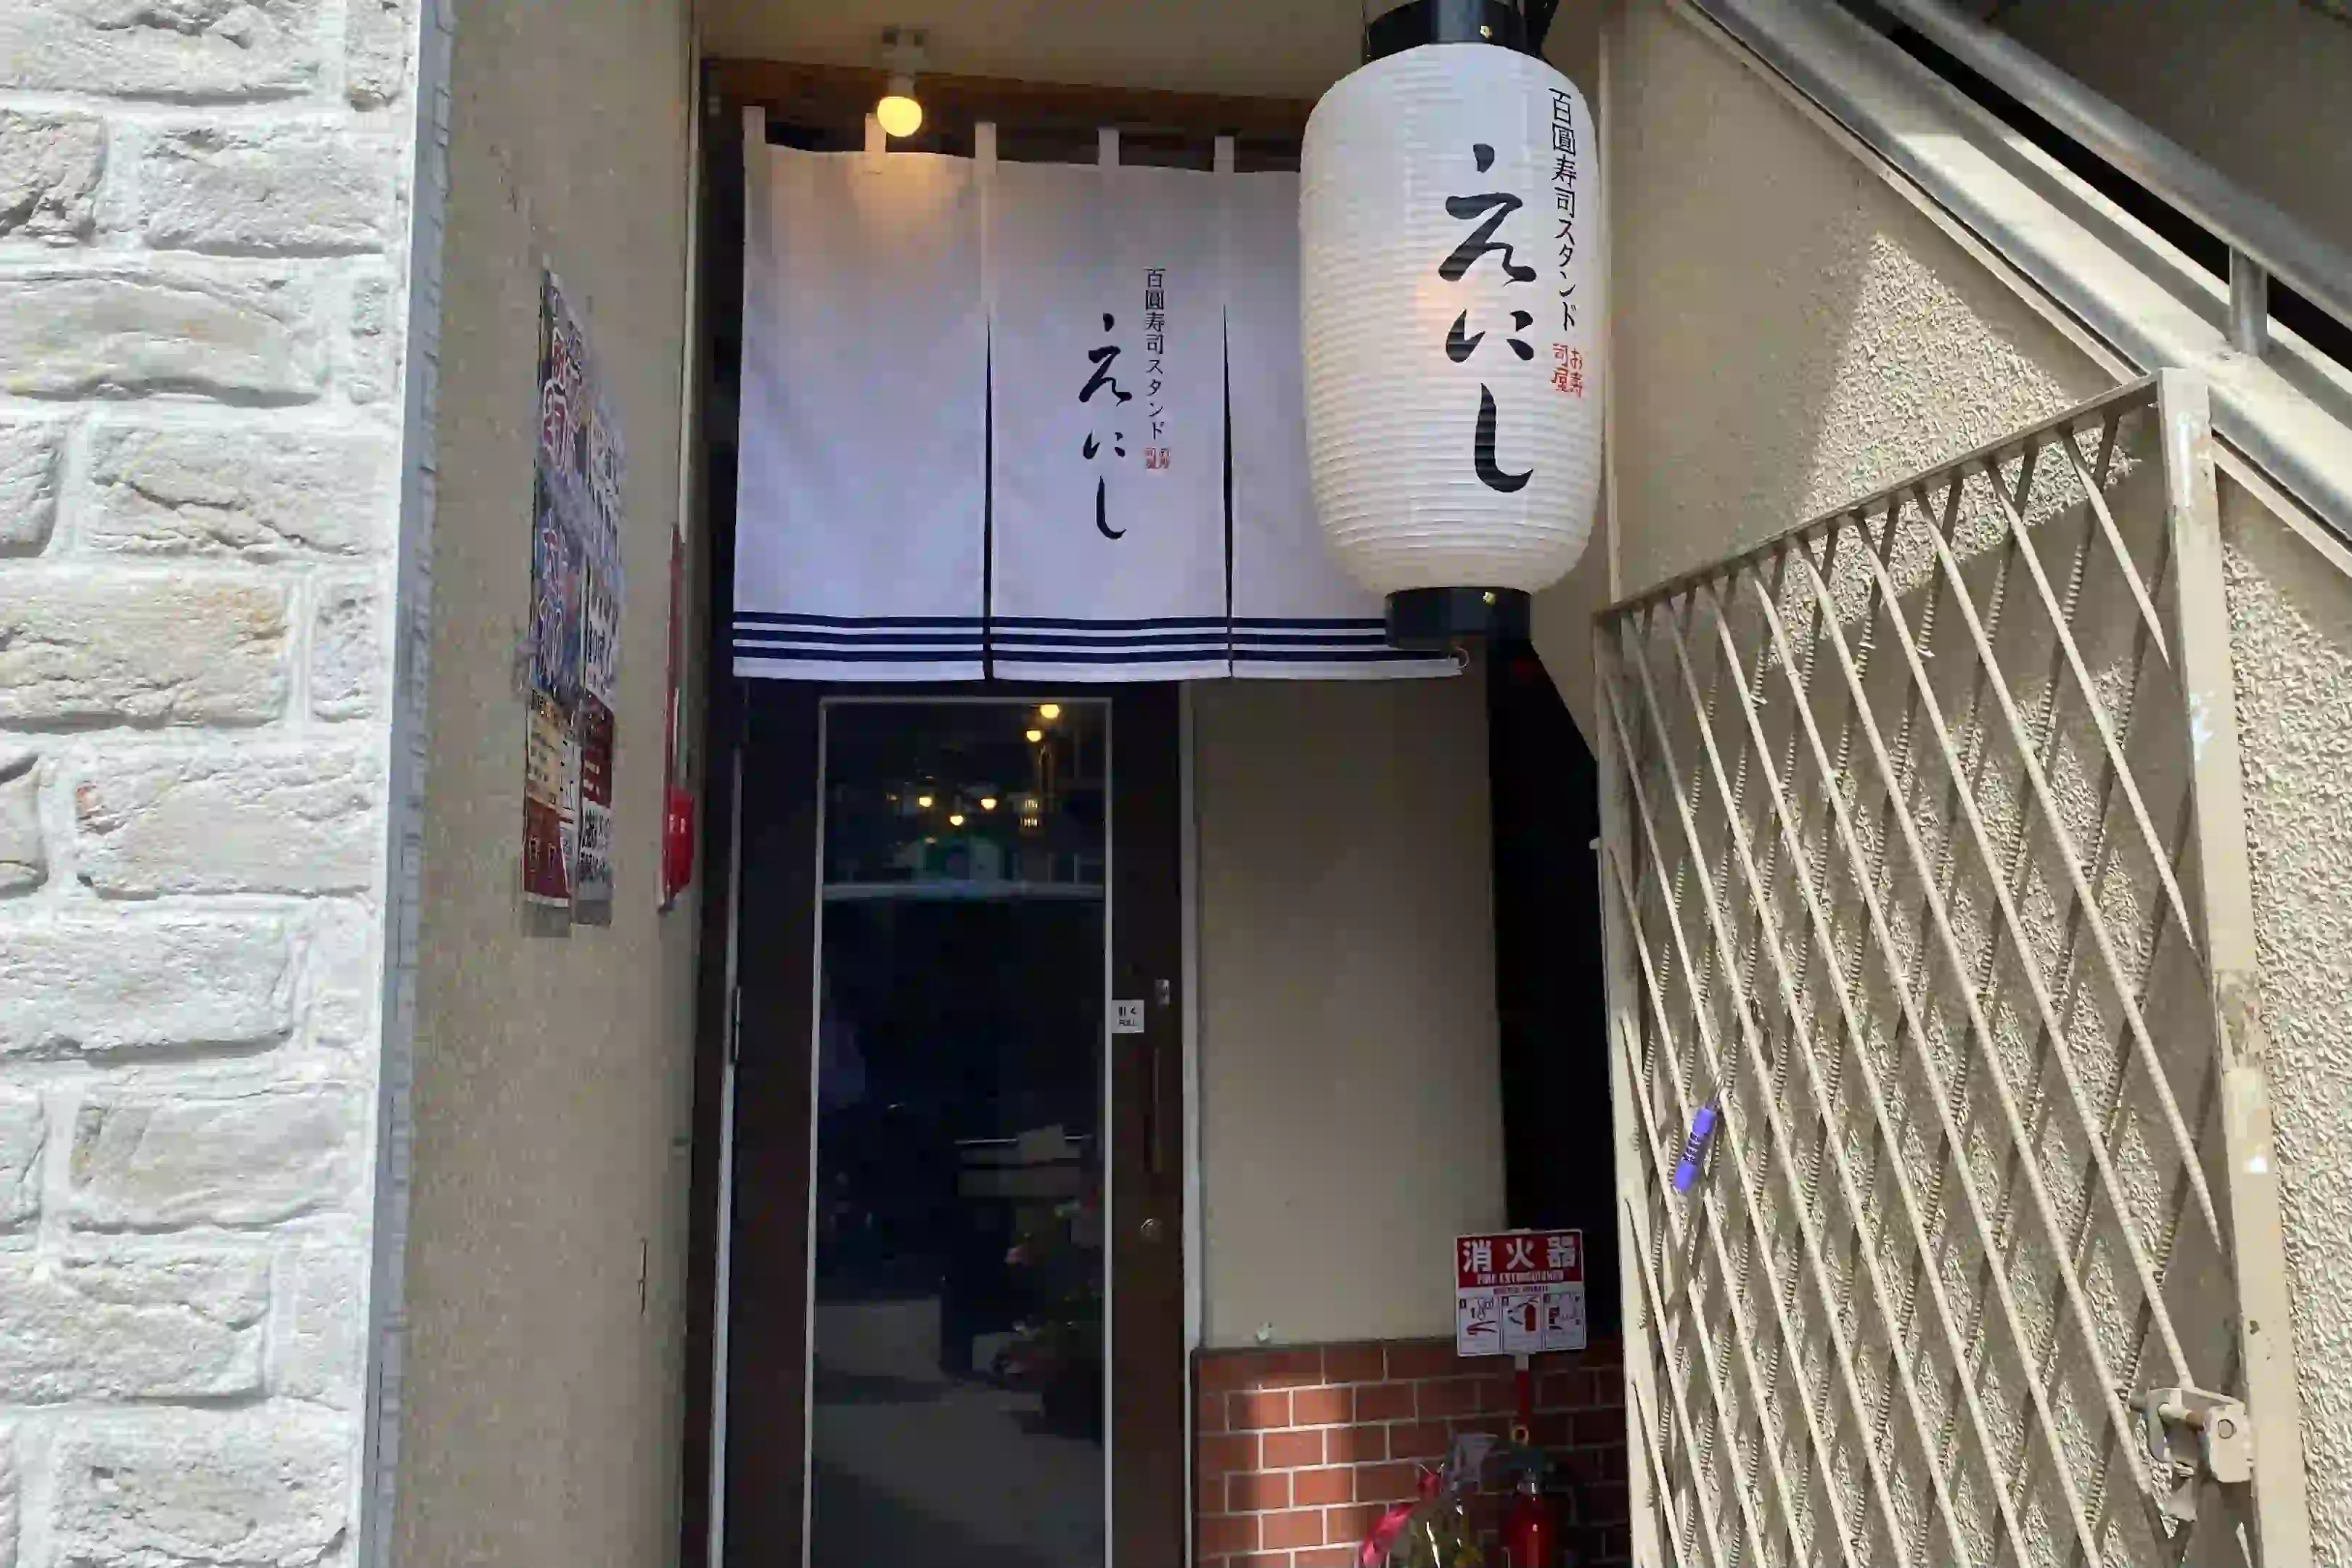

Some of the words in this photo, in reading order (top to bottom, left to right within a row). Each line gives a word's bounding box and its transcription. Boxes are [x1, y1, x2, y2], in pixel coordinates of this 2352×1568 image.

[1438, 144, 1537, 493] えにし
[1548, 87, 1577, 332] 百圓寿司スタンド
[1078, 312, 1132, 540] えにし
[1142, 267, 1166, 440] 百圓寿司スタンド
[1462, 1236, 1576, 1273] 消火器
